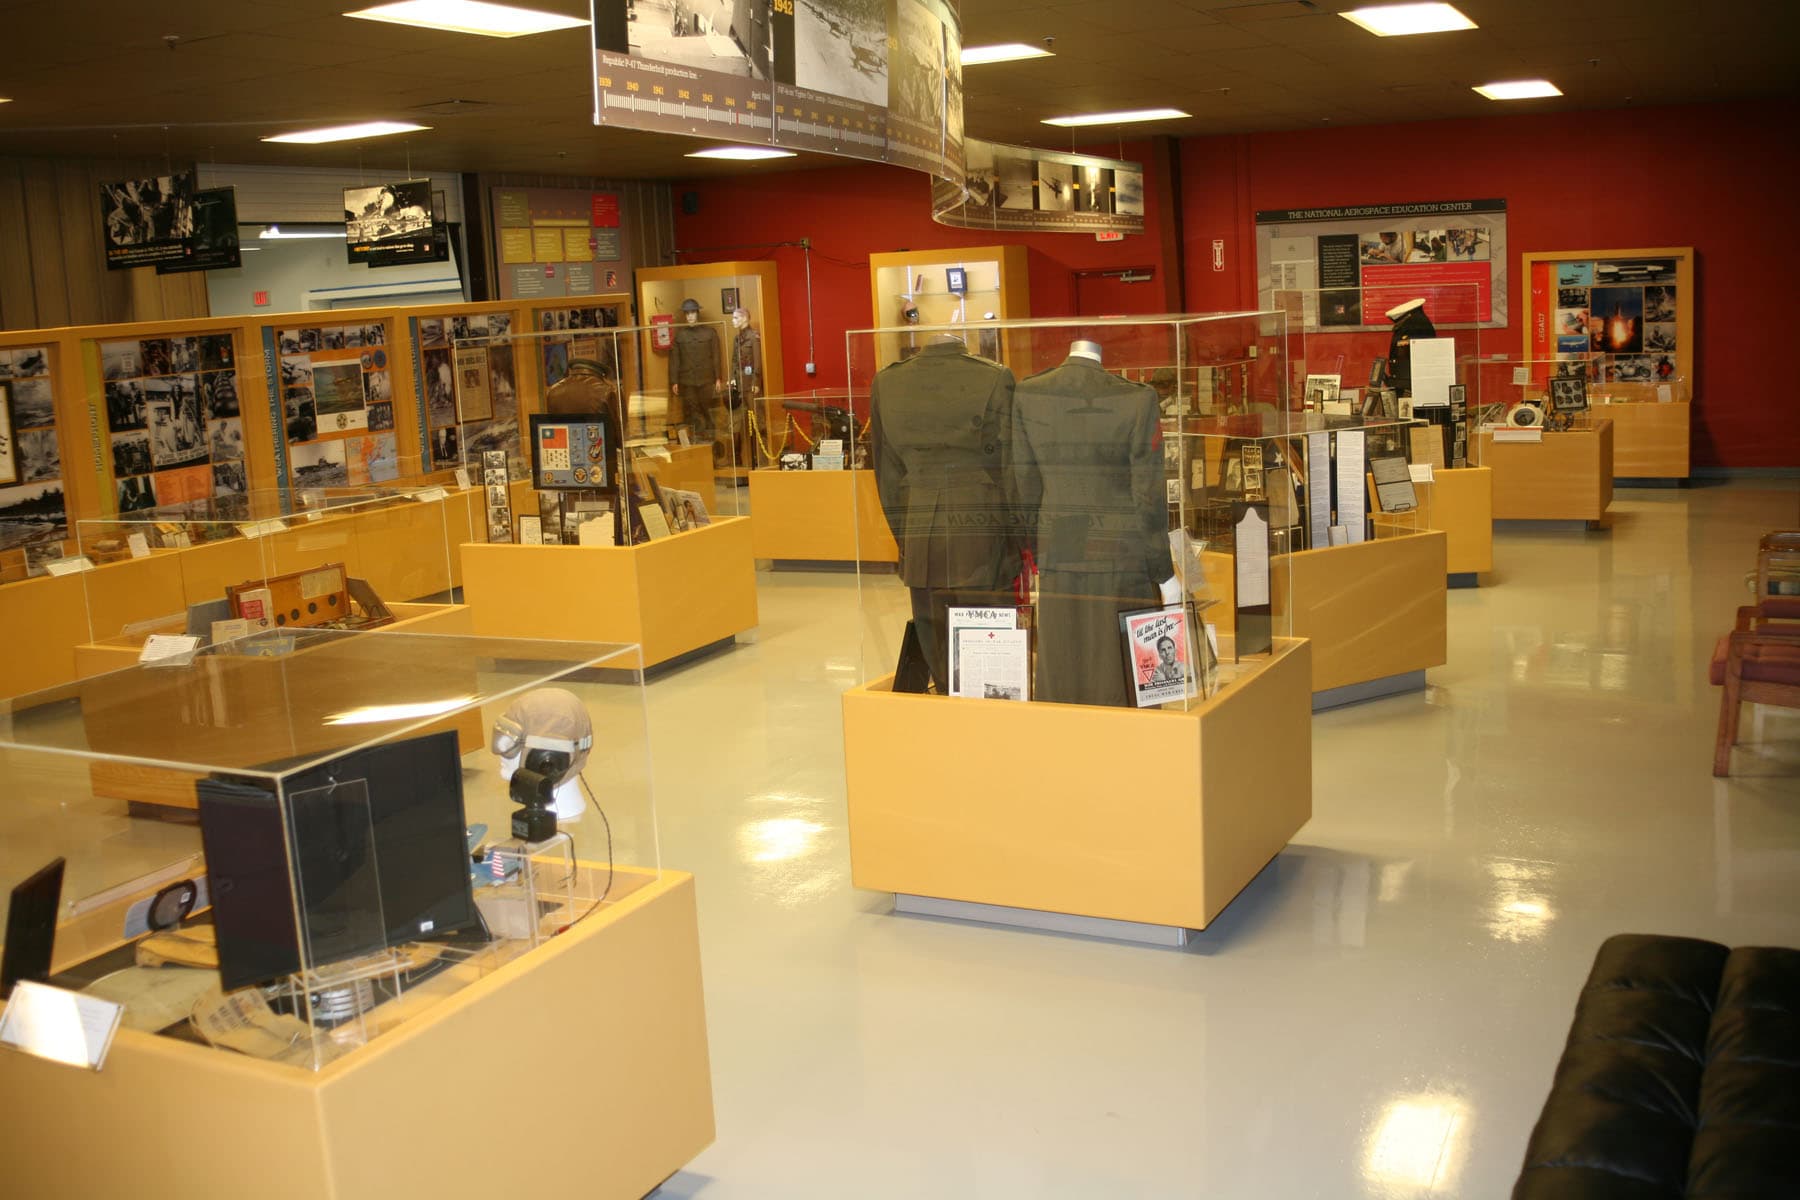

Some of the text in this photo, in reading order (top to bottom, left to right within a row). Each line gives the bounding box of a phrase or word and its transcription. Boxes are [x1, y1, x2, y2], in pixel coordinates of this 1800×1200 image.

[774, 0, 793, 16] 1942
[602, 55, 625, 68] Republic
[637, 61, 664, 74] Thunderbolt
[626, 80, 639, 92] 1940
[653, 85, 665, 96] 1941
[678, 89, 690, 100] 1942
[1288, 202, 1472, 219] THE NATIONAL AEROSPACE EDUCATION CENTER
[264, 349, 283, 479] WEATHERING THE STORM
[968, 610, 998, 620] YMCA
[1144, 623, 1154, 634] the
[1155, 616, 1167, 629] last
[1143, 633, 1157, 644] man
[1158, 627, 1164, 635] is
